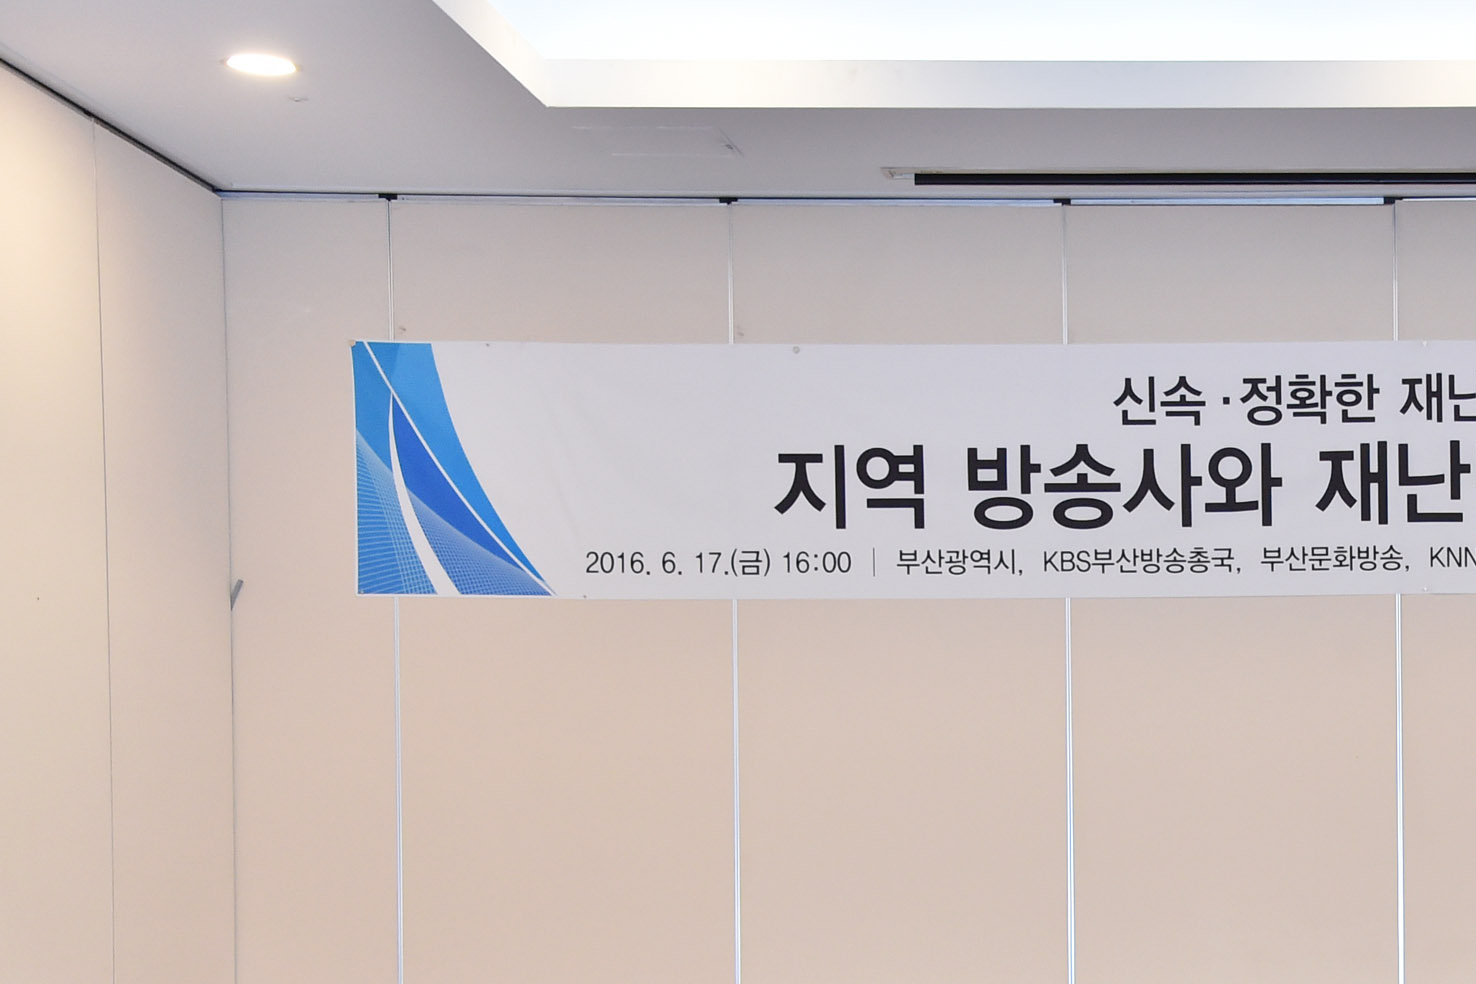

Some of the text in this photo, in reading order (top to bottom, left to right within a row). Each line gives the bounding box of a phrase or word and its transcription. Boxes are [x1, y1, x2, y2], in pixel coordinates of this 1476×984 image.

[774, 444, 925, 530] 지역
[967, 442, 1283, 530] 방송사와
[585, 551, 651, 576] 2016.
[661, 551, 683, 576] 6.
[783, 550, 852, 574] 16:00
[896, 548, 1023, 576] 부산광역시,
[1043, 546, 1241, 574] KBS부산방송총국,
[1260, 544, 1410, 573] 부산문화방송,
